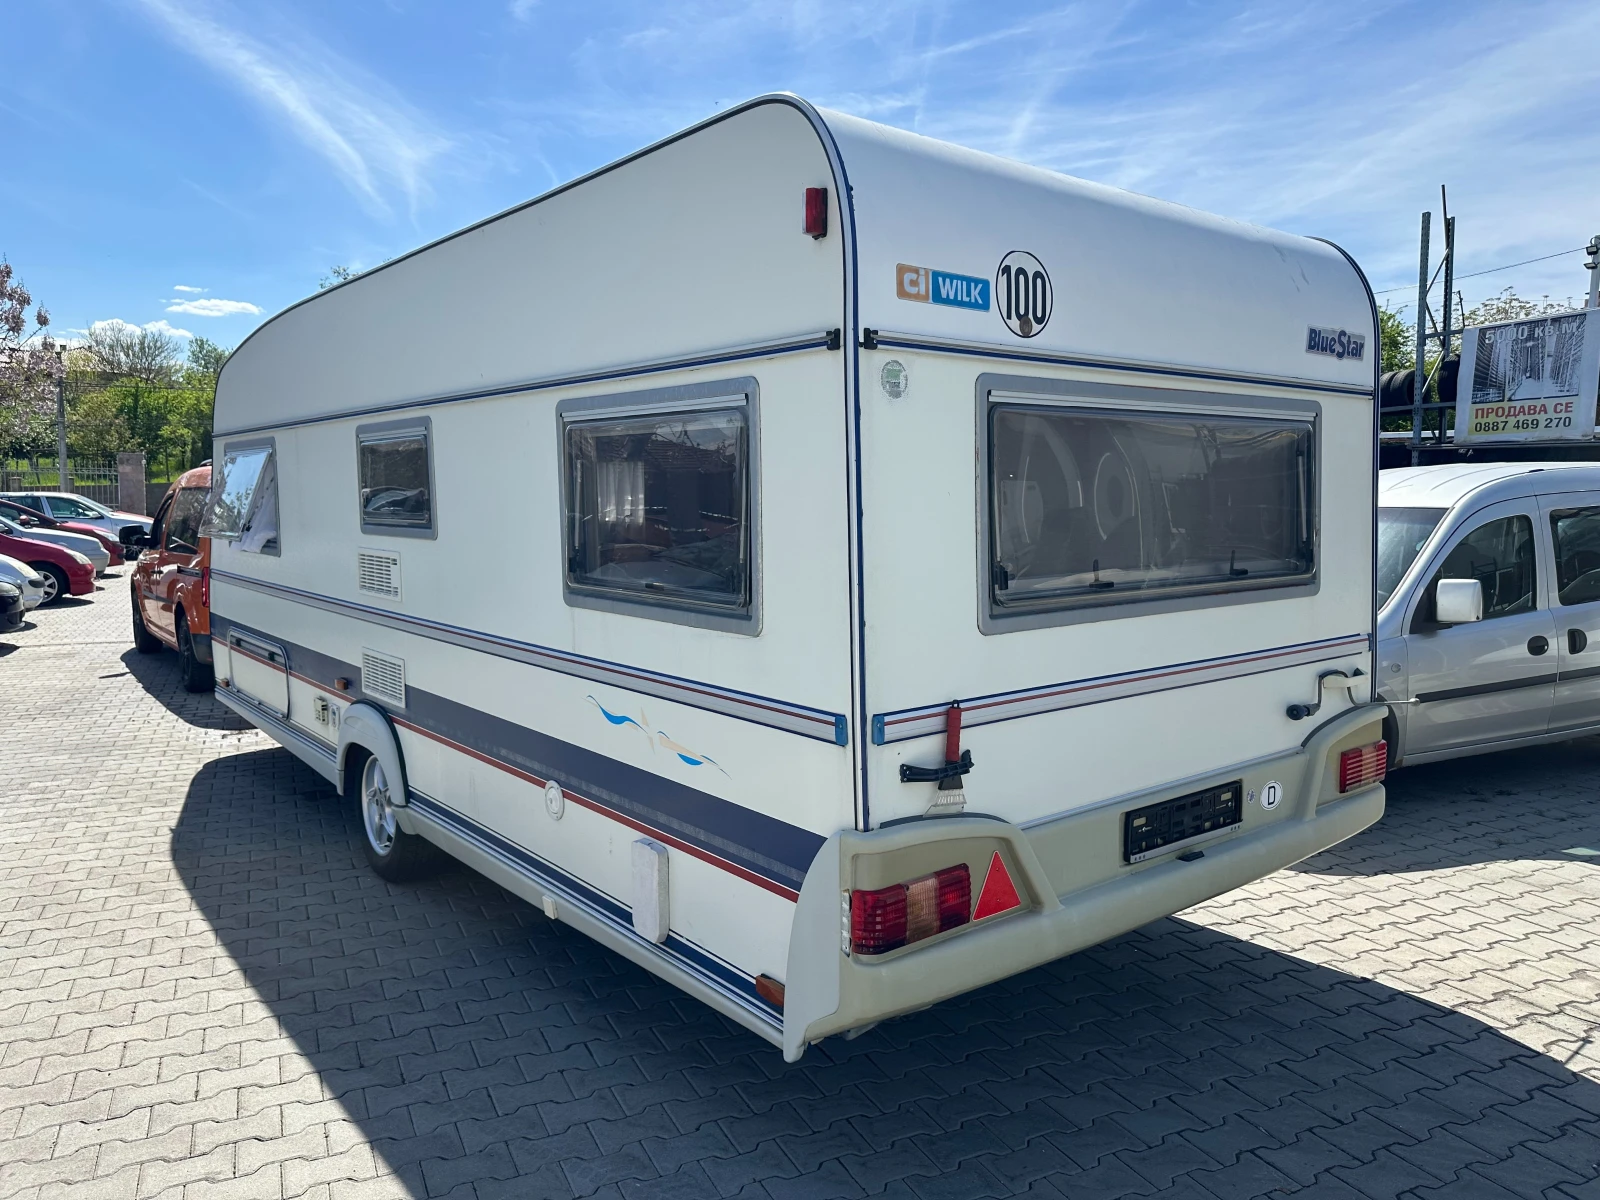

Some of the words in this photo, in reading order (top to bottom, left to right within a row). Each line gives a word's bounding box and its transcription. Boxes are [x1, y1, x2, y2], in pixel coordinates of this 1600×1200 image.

[938, 276, 983, 305] WILK
[1001, 264, 1047, 326] 100
[1485, 325, 1528, 344] 5000
[1474, 403, 1548, 419] ПРОДАВА
[1553, 402, 1574, 414] СЕ
[1474, 420, 1509, 432] 0887
[1513, 418, 1540, 430] 469
[1544, 416, 1572, 428] 270
[1267, 785, 1276, 806] D
